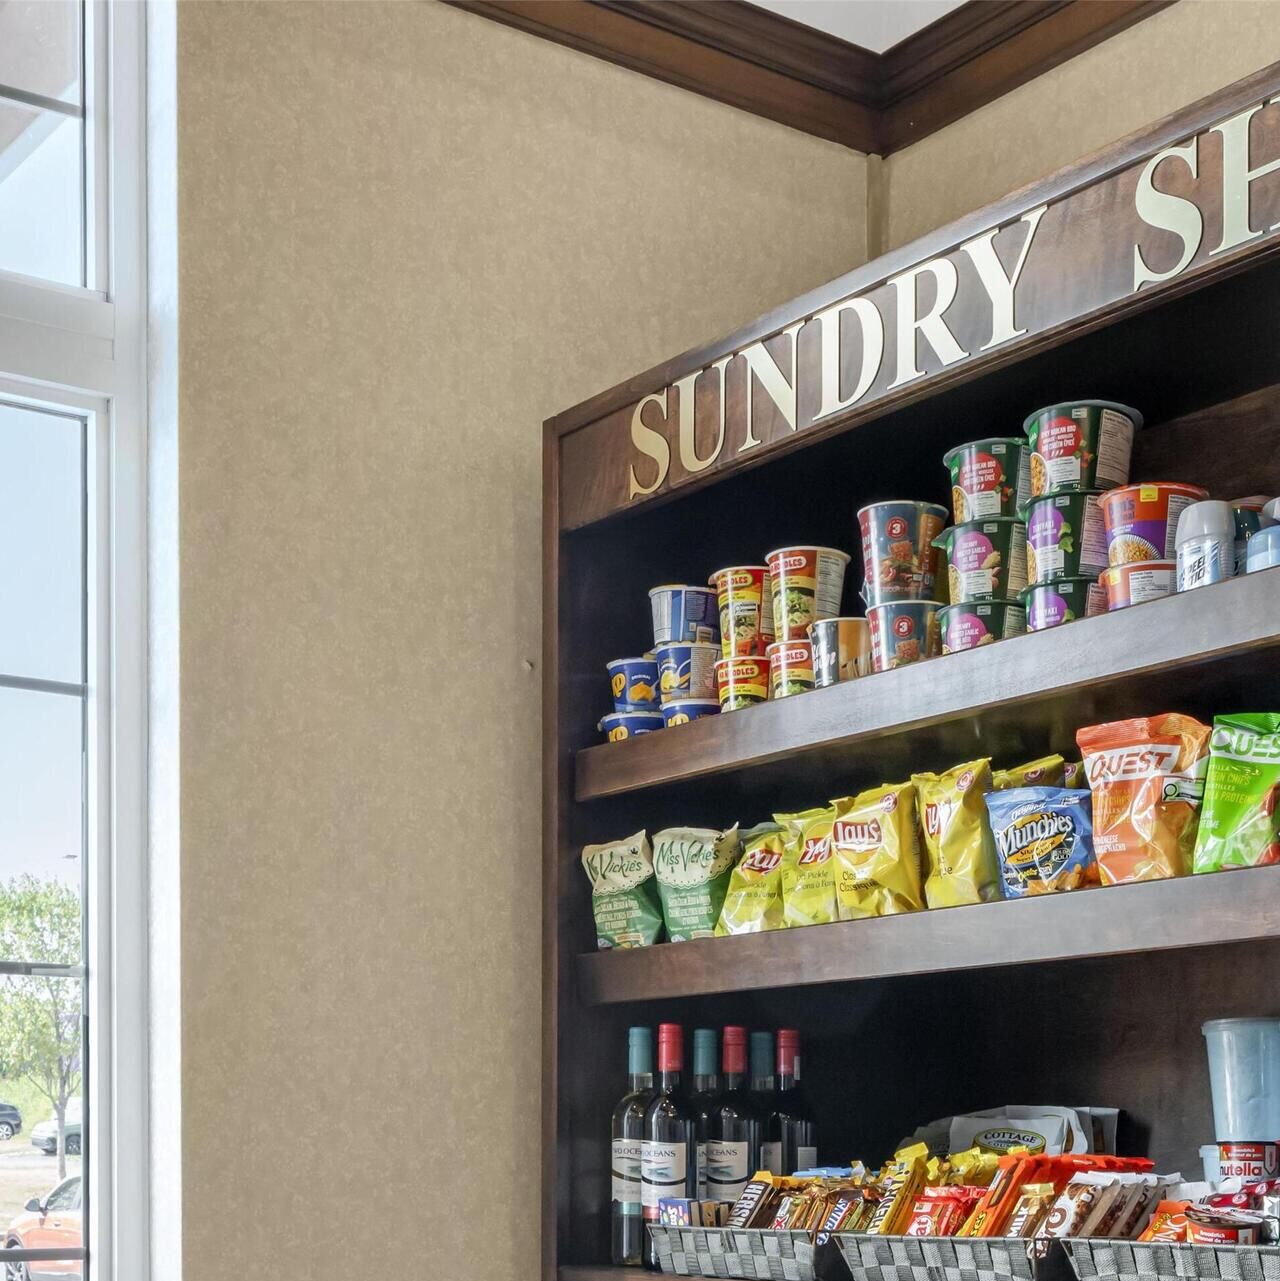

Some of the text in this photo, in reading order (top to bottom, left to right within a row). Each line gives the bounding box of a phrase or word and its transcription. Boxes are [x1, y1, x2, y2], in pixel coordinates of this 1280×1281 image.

[628, 204, 1048, 500] SUNDRY
[891, 523, 901, 534] 3
[898, 622, 908, 633] 3
[1088, 751, 1173, 785] QUEST
[1000, 812, 1073, 854] Munchies
[600, 851, 642, 880] Vickie's
[680, 839, 720, 873] Vickie's
[984, 1130, 1037, 1145] COTTAGE
[1220, 1162, 1263, 1176] nutella
[727, 1183, 763, 1228] HERSH
[1008, 1206, 1029, 1237] MILK
